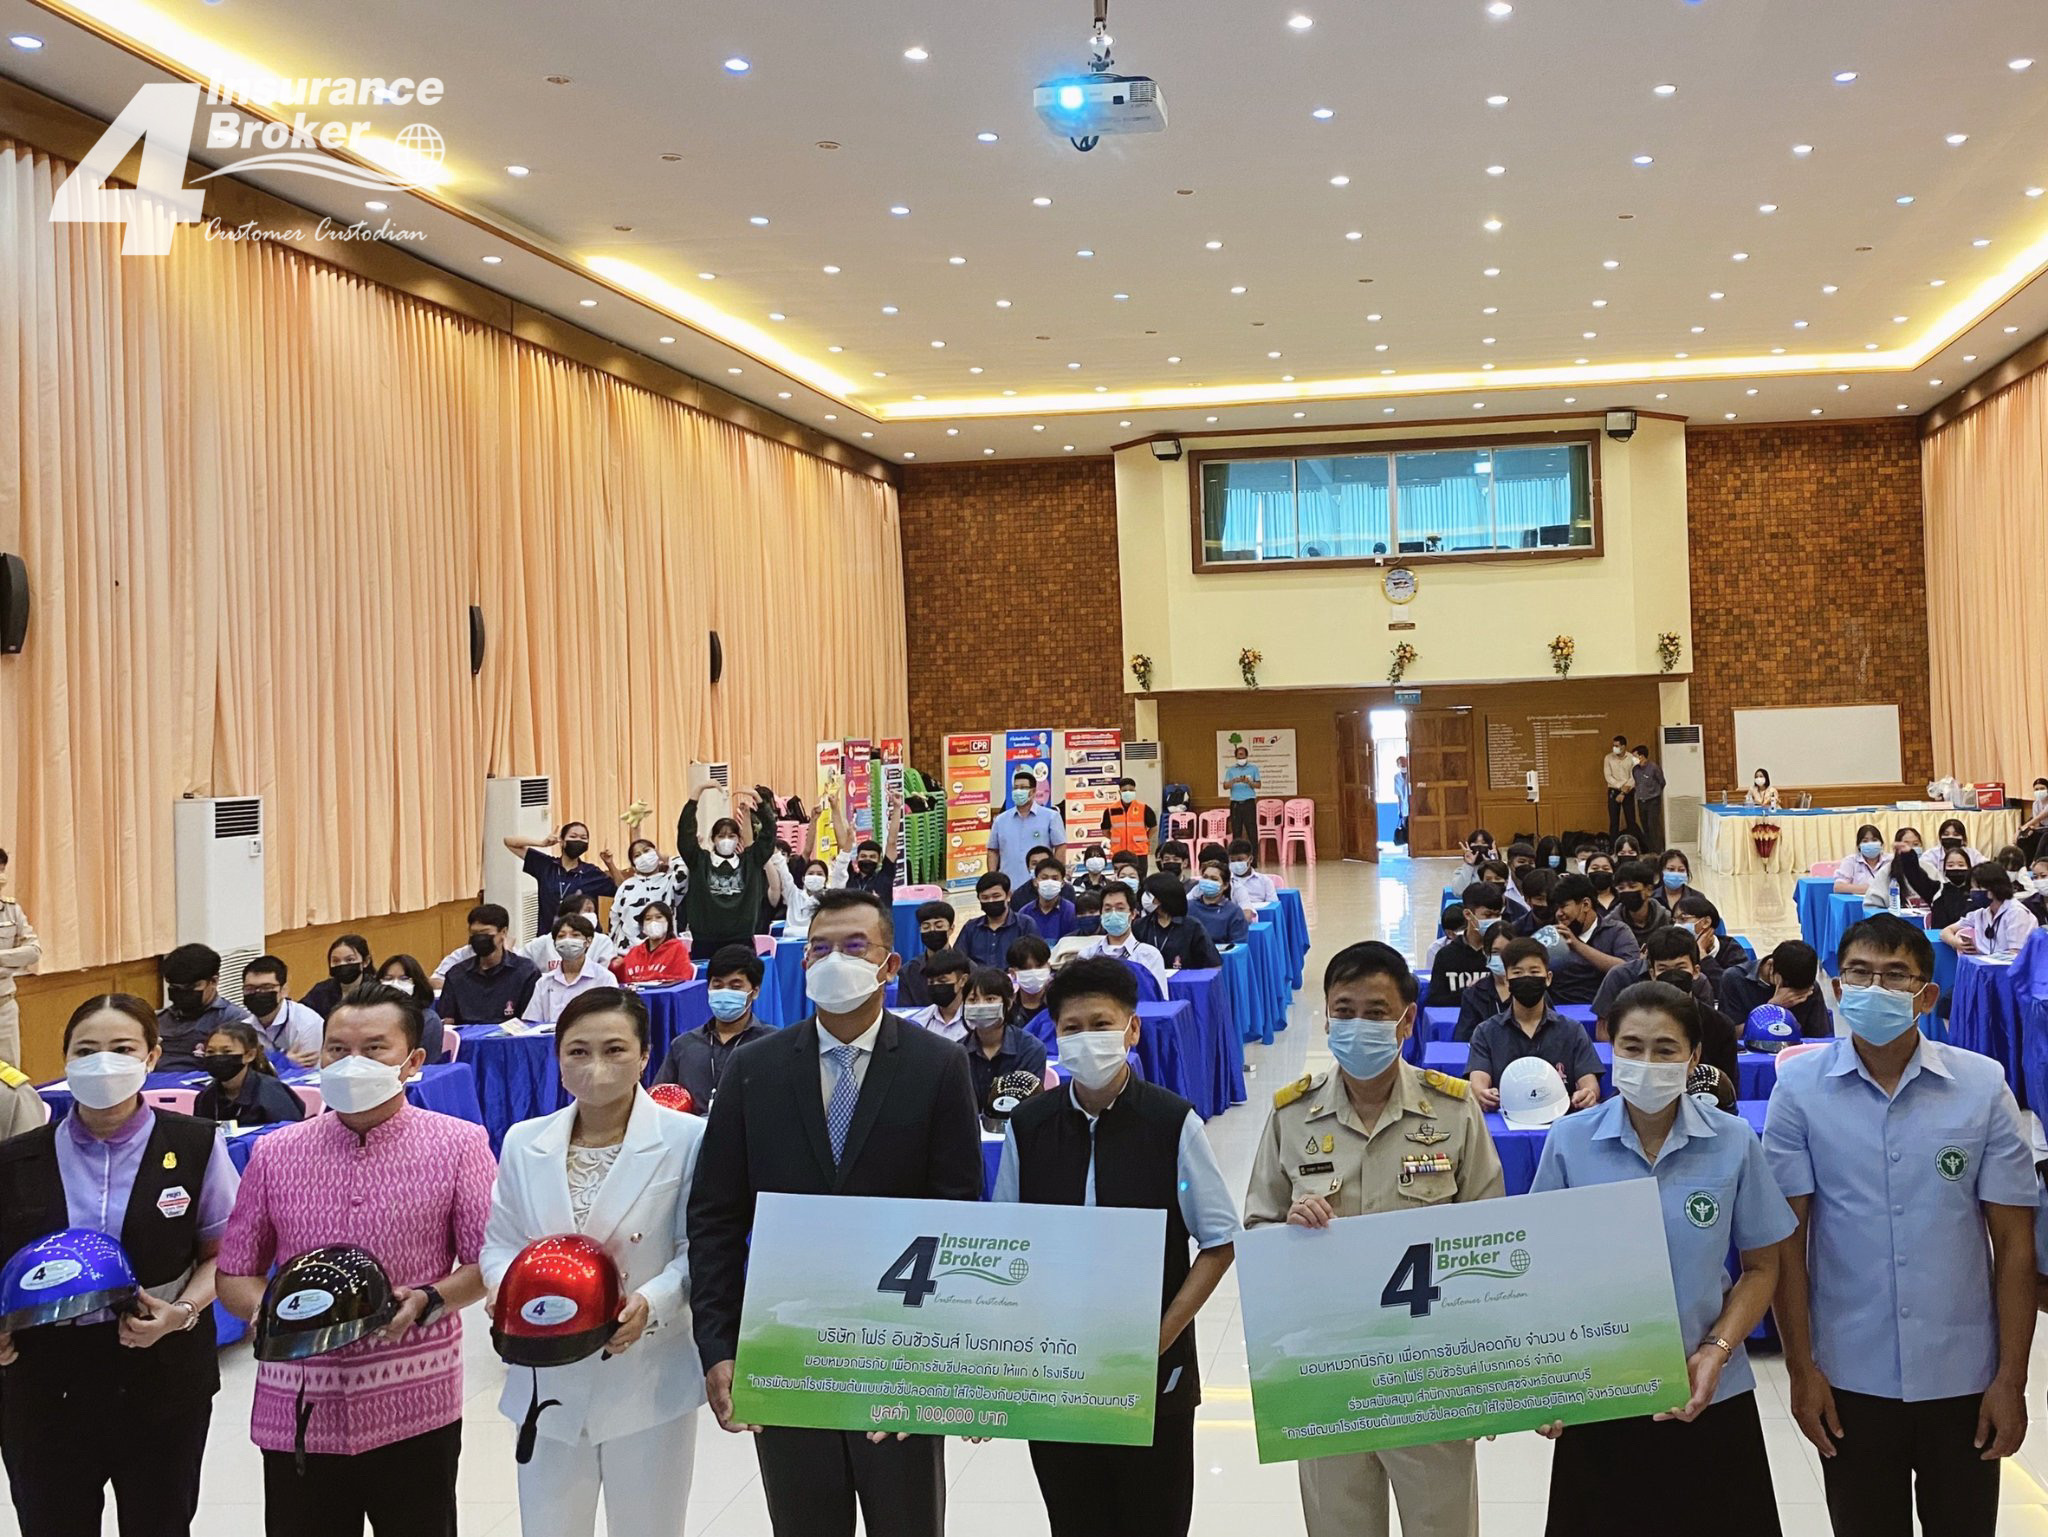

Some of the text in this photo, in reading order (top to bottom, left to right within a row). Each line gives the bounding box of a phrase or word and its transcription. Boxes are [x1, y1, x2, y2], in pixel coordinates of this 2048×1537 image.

[972, 741, 988, 751] CPR
[940, 1233, 1031, 1251] Insurance
[1435, 1229, 1526, 1253] Insurance
[938, 1250, 1002, 1268] Broker
[1437, 1250, 1500, 1270] Broker
[33, 1266, 46, 1280] 4
[877, 1236, 940, 1308] 4
[1380, 1243, 1441, 1318] 4
[287, 1295, 300, 1310] 4
[532, 1301, 545, 1315] 4
[817, 1327, 1077, 1355] บริษัท โฟร์ อินชัวรันส์ โบรกเกอร์ จำกัด
[1300, 1322, 1629, 1375] มอบหมวกนิรภัย เพื่อการขับขี่ปลอดภัย จำนวน 6 โรงเรียน
[805, 1355, 887, 1370] มอบหมวกนิรภัย
[891, 1354, 999, 1376] เพื่อการขับขี่ปลอดภัย
[1032, 1368, 1039, 1377] 6
[1043, 1365, 1085, 1380] โรงเรียน
[1373, 1353, 1562, 1387] บริษัท โฟร์ อินชัวรันส์ โบรกเกอร์ จำกัด
[1349, 1368, 1592, 1410] ร่วมสนับสนุน สำนักงานสาธารณสุขจังหวัดนนทบุรี
[871, 1402, 1008, 1426] มูลค่า 100,000 บาท
